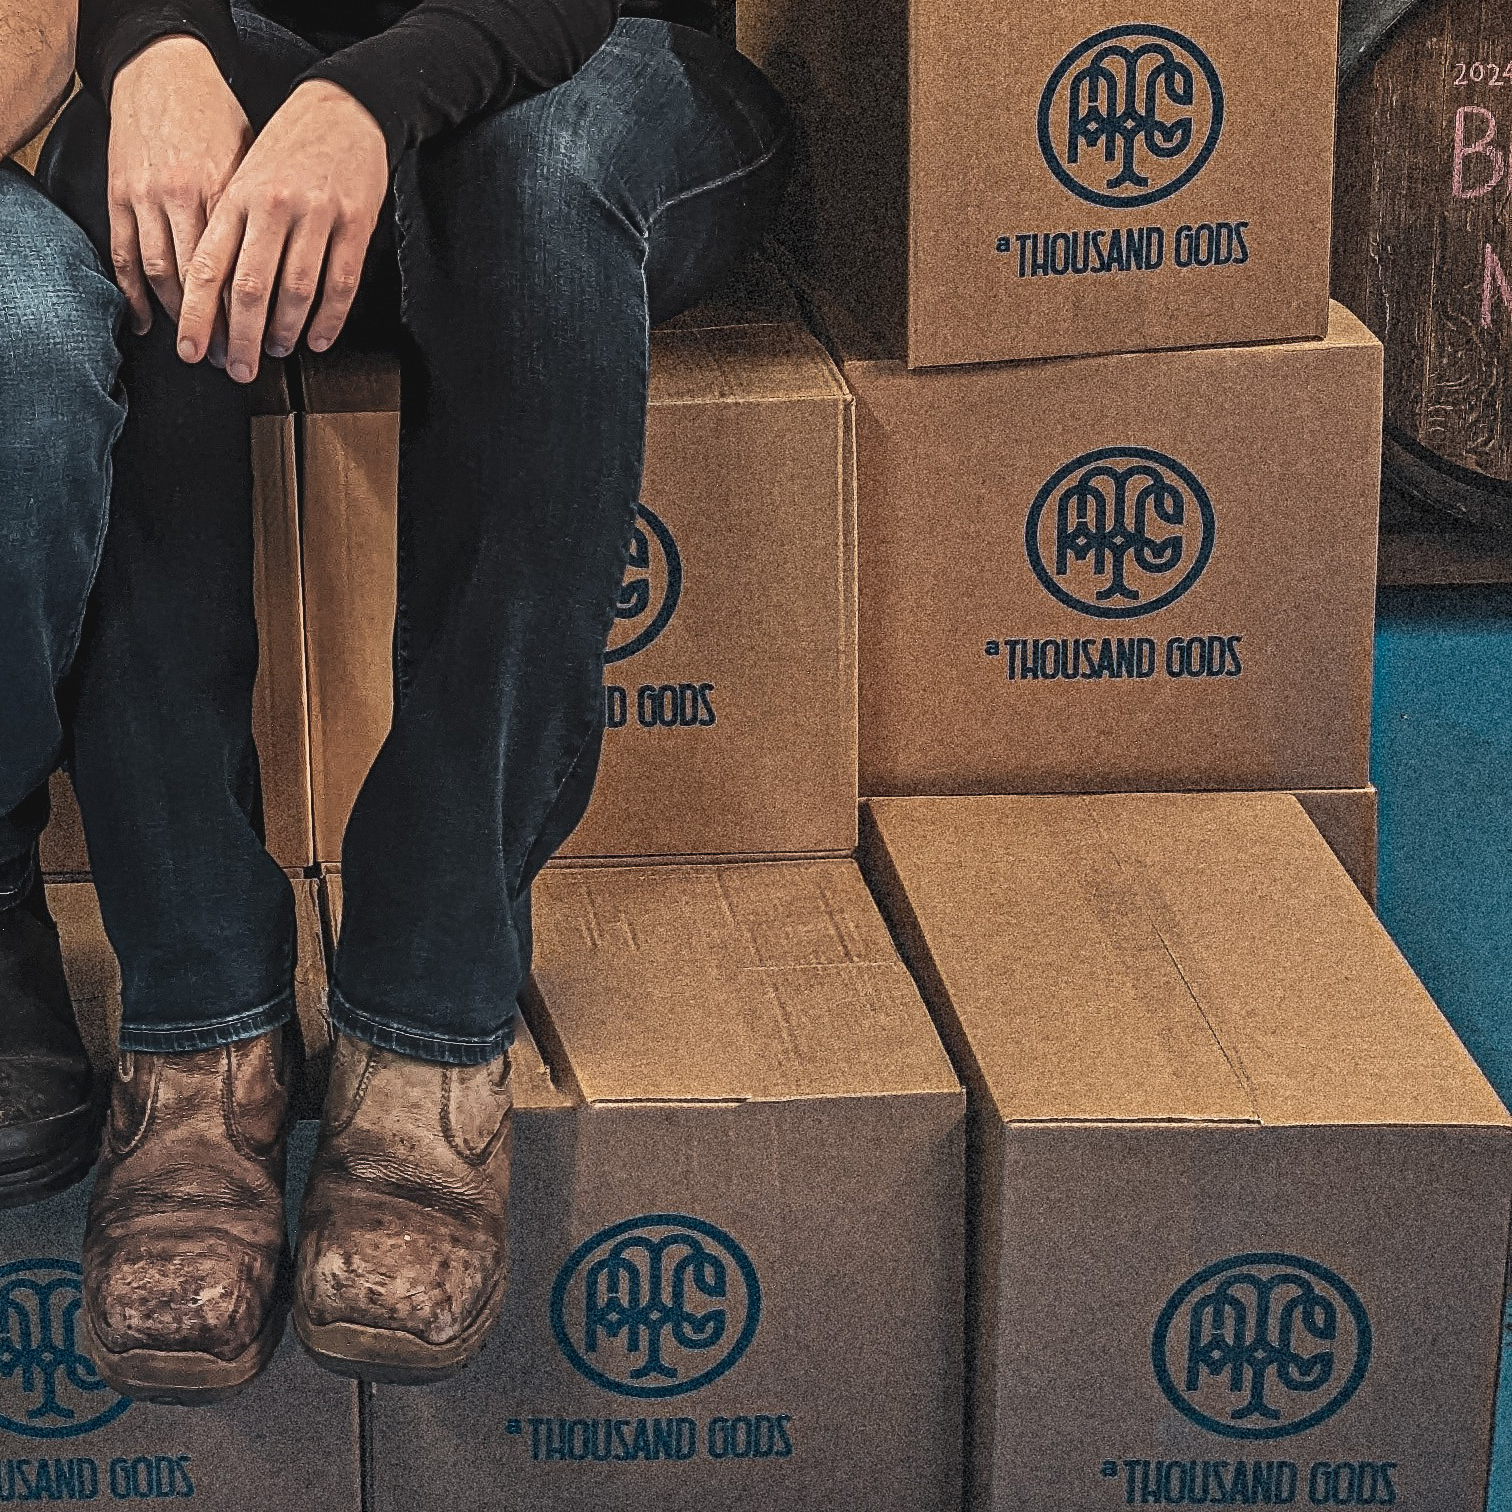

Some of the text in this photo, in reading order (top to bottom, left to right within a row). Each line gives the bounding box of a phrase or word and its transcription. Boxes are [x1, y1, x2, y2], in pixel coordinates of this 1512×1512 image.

[1015, 226, 1166, 279] THOUSAND
[1174, 220, 1250, 269] GODS
[1003, 636, 1157, 682] THOUSAND
[1165, 635, 1244, 680] GODS
[636, 682, 717, 728] GODS
[528, 1417, 698, 1462] THOUSAND
[707, 1414, 794, 1460] GODS
[108, 1453, 196, 1501] GODS
[1122, 1459, 1300, 1506] THOUSAND
[1308, 1460, 1399, 1506] GODS
